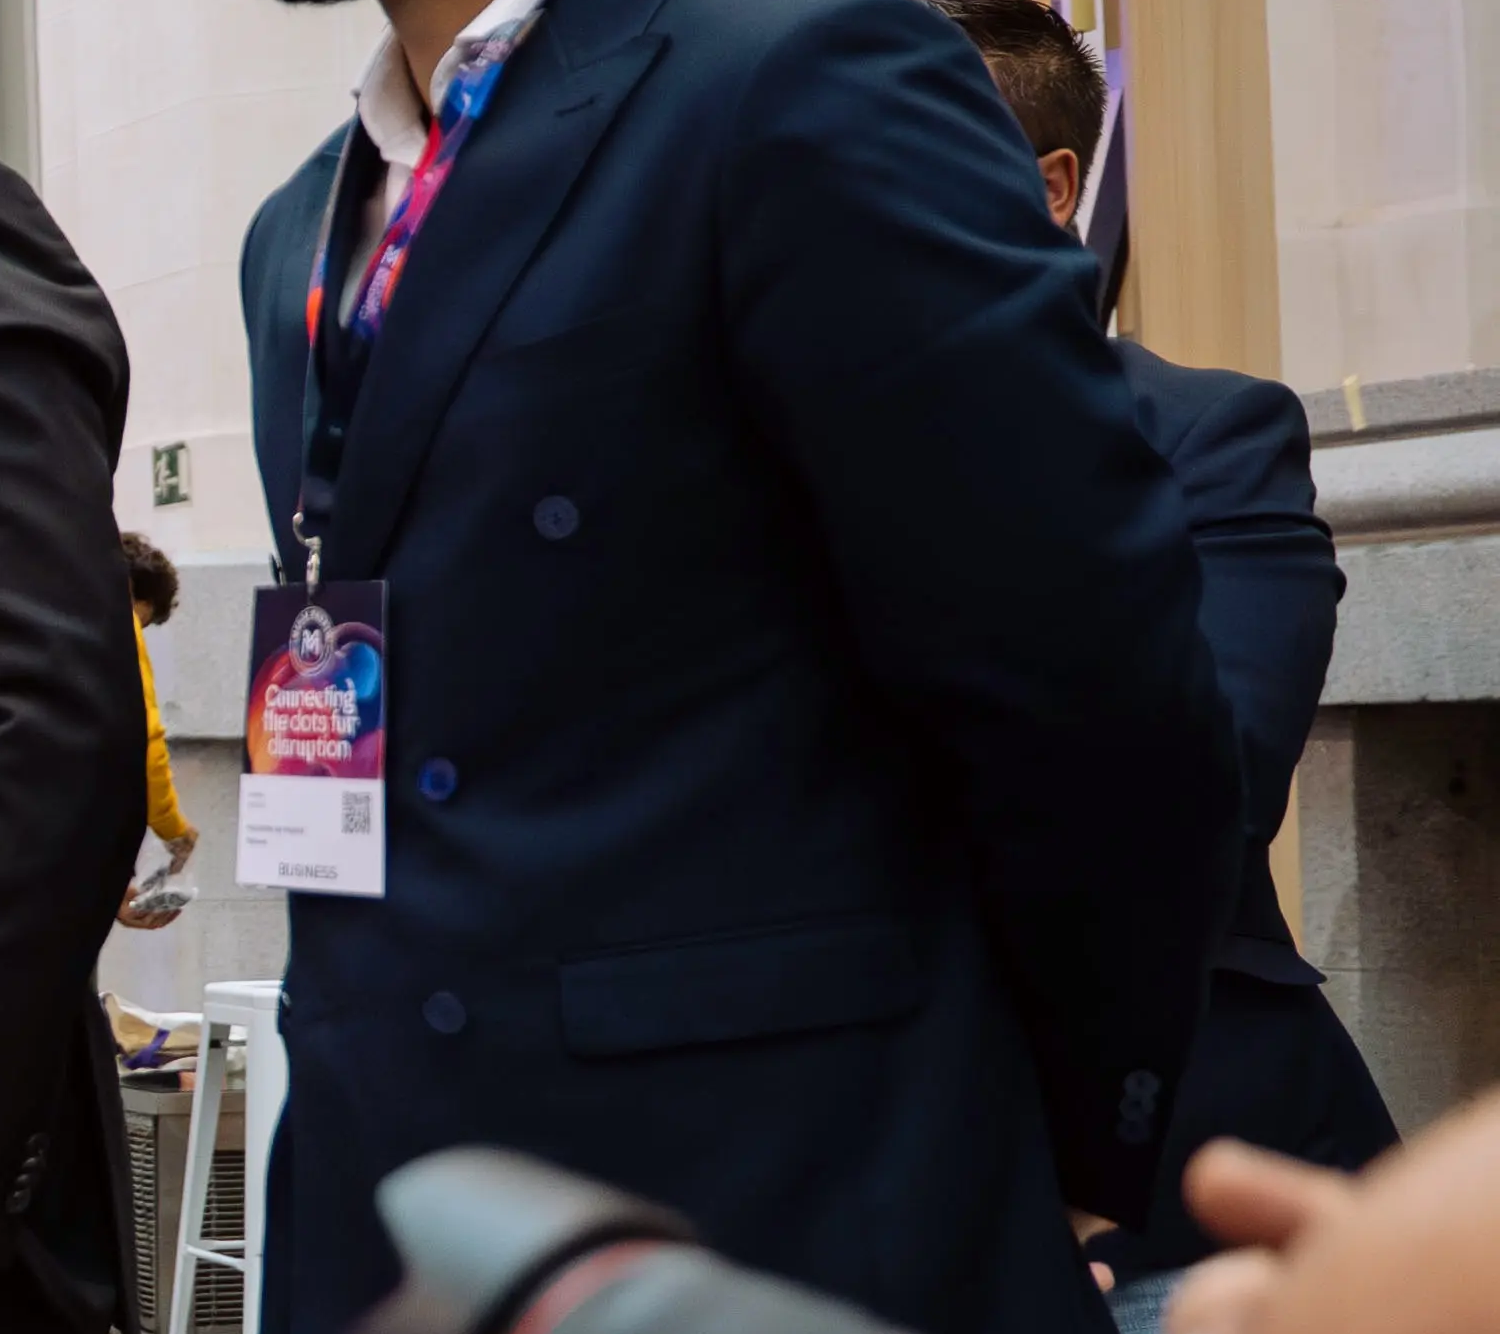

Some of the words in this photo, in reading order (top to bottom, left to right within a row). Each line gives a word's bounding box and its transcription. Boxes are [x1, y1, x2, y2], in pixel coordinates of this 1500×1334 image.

[265, 679, 358, 714] Connecting
[263, 711, 288, 731] the
[290, 710, 328, 734] dots
[267, 737, 352, 763] disruption
[278, 862, 339, 879] BUSINESS
